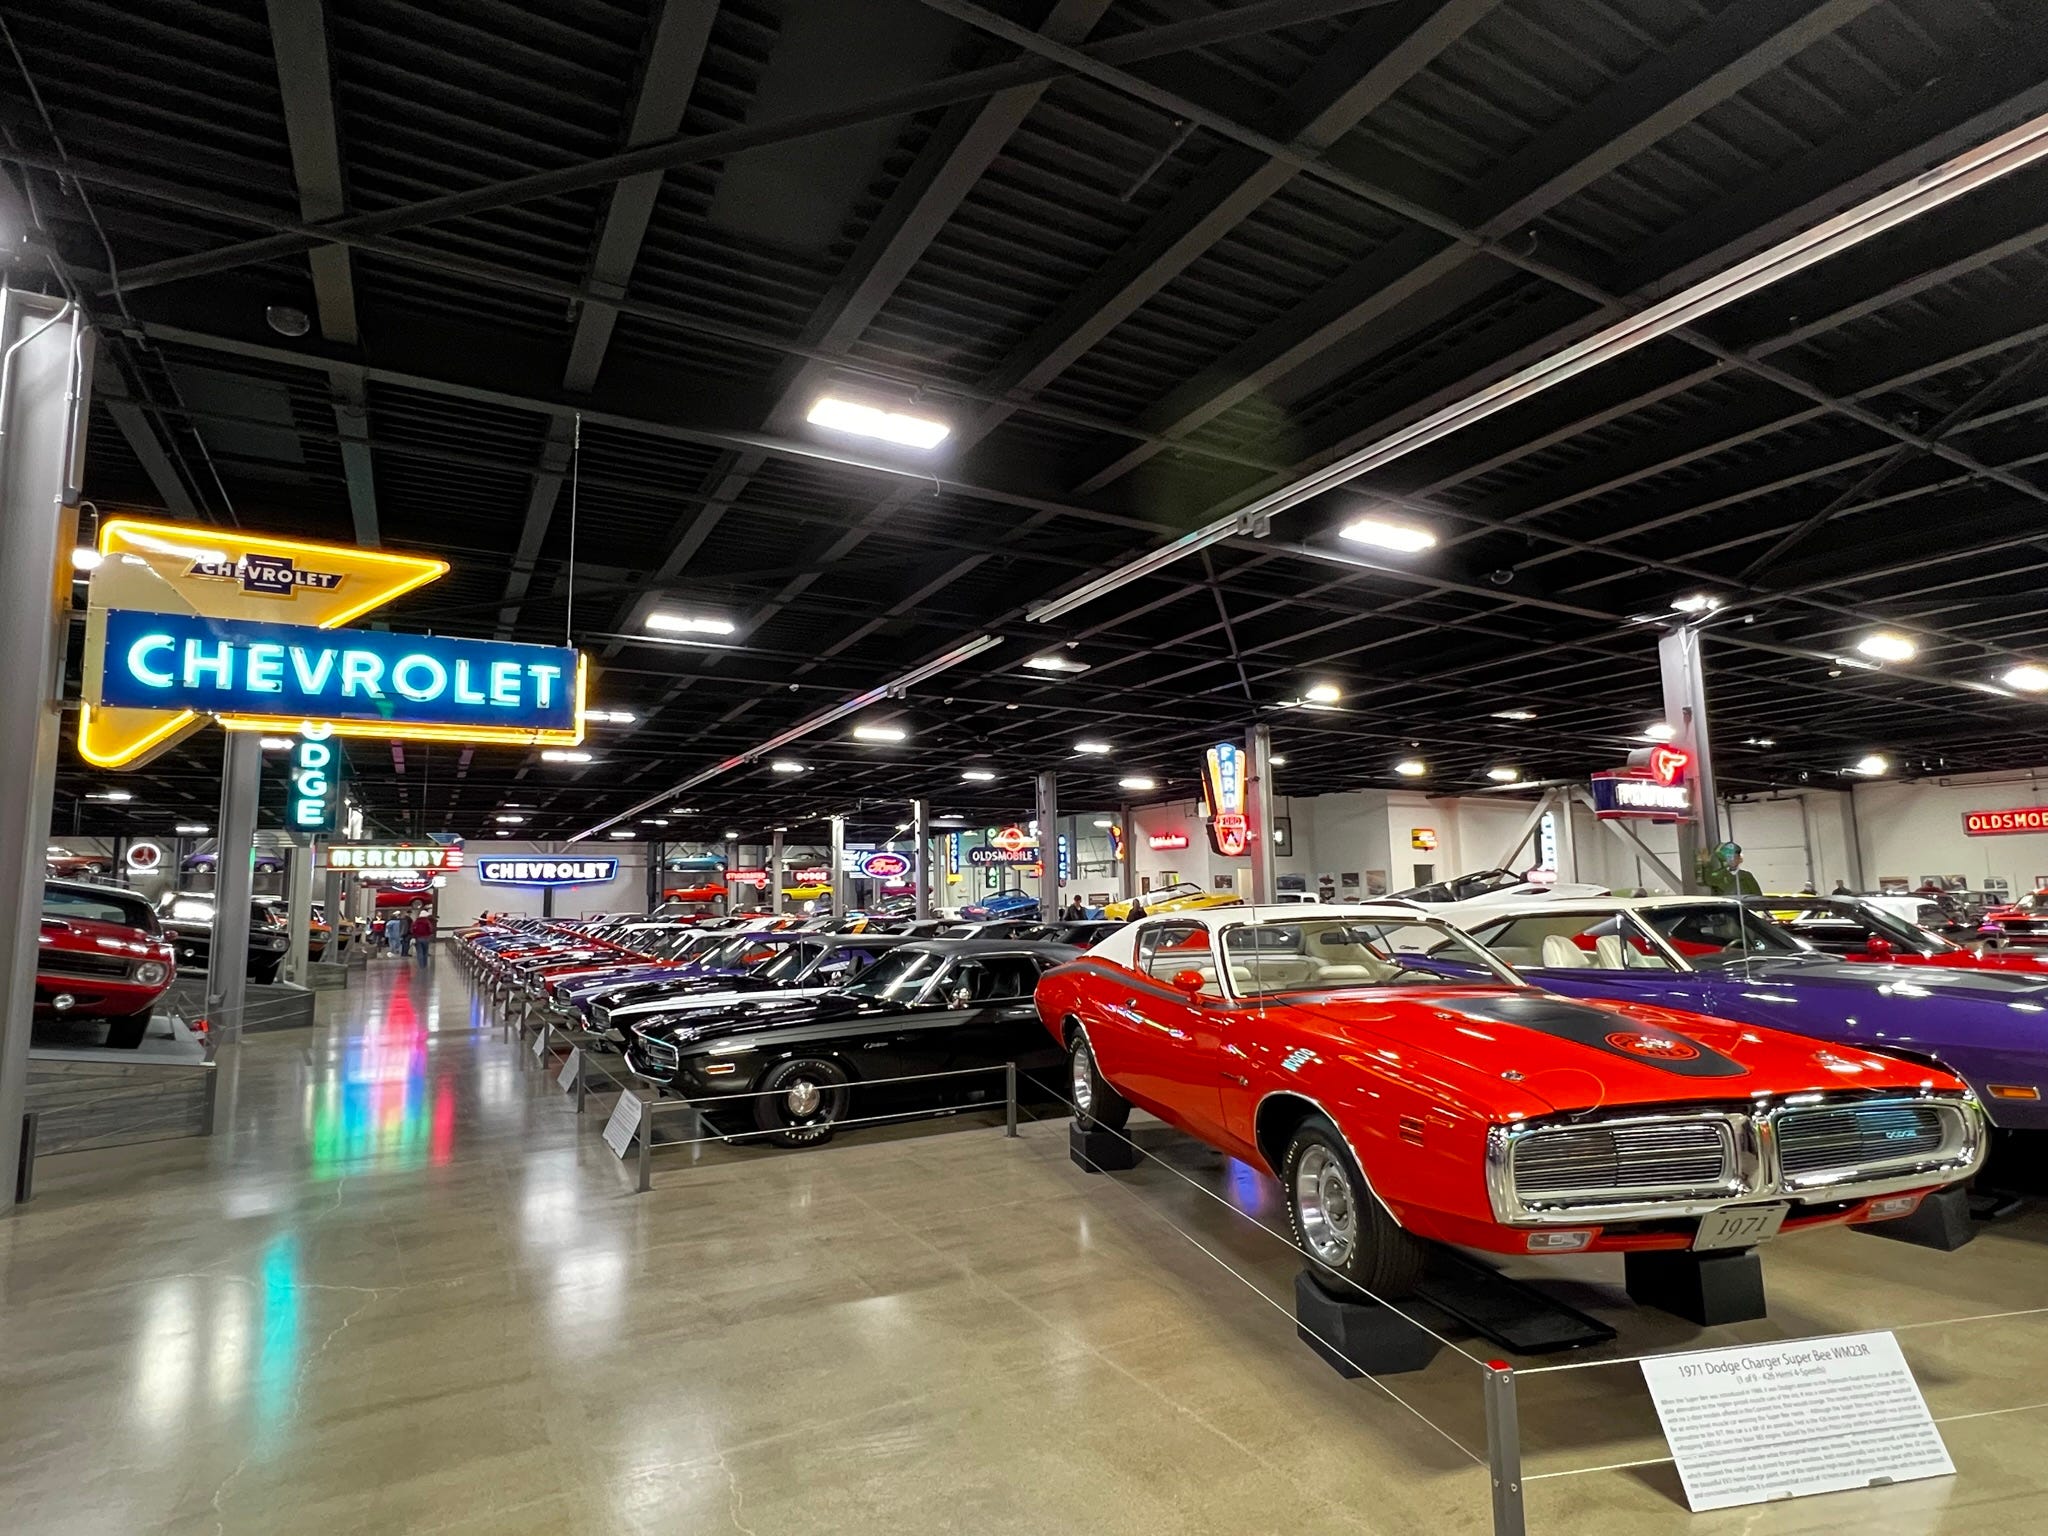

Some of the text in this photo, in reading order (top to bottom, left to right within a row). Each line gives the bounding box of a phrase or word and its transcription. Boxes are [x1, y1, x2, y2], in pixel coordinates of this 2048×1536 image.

[201, 561, 333, 588] CHEVROLET
[127, 634, 562, 709] CHEVROLET
[297, 719, 335, 825] ODGE
[1220, 746, 1236, 809] FORD
[331, 849, 446, 868] MERCURY
[867, 857, 904, 875] Ford
[972, 850, 1033, 862] OLDSMOBILE
[1058, 836, 1067, 879] BUICK
[485, 862, 610, 880] CHEVROLET
[795, 871, 828, 881] DODGE
[1716, 1216, 1769, 1241] 1971
[1678, 1343, 1871, 1378] 1971 Dodge Charger Super Bee WM23R
